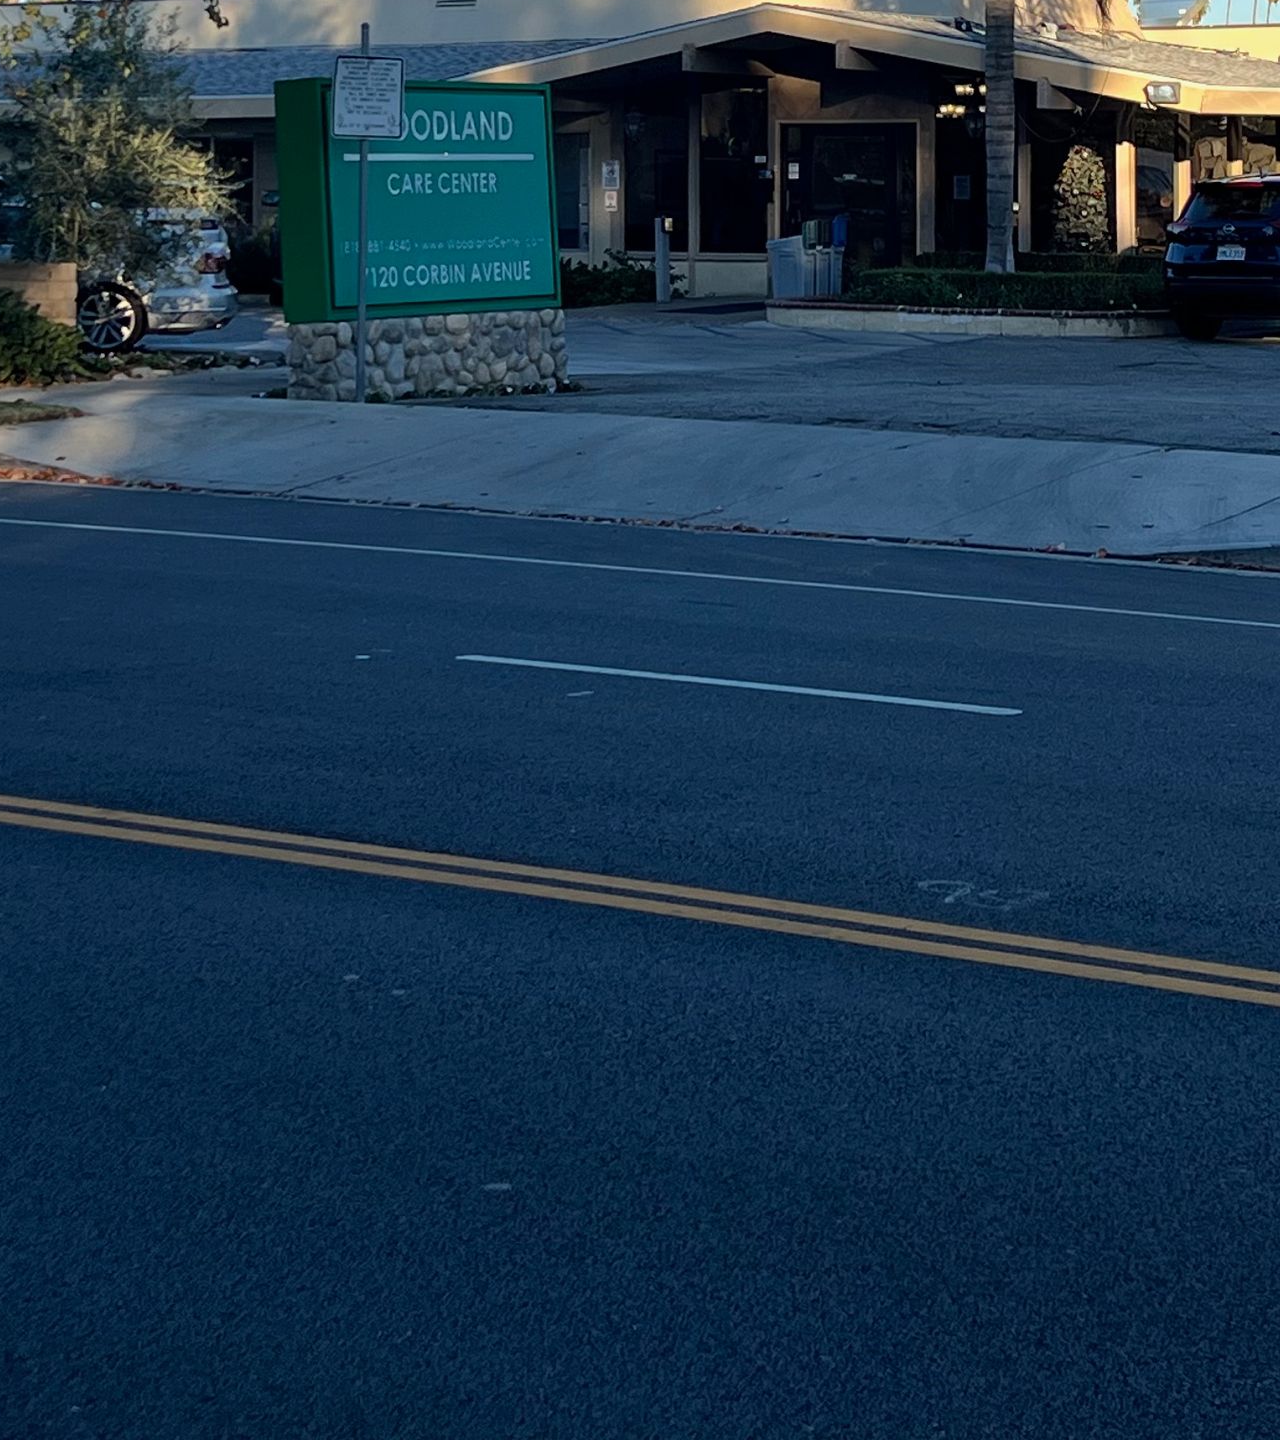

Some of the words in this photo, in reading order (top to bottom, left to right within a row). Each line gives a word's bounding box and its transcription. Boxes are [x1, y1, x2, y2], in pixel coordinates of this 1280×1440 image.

[401, 109, 513, 141] ODLAND
[387, 173, 433, 195] CARE
[437, 172, 498, 194] CENTER
[365, 266, 398, 288] 120
[403, 264, 465, 287] CORBIN
[471, 260, 532, 283] AVENUE
